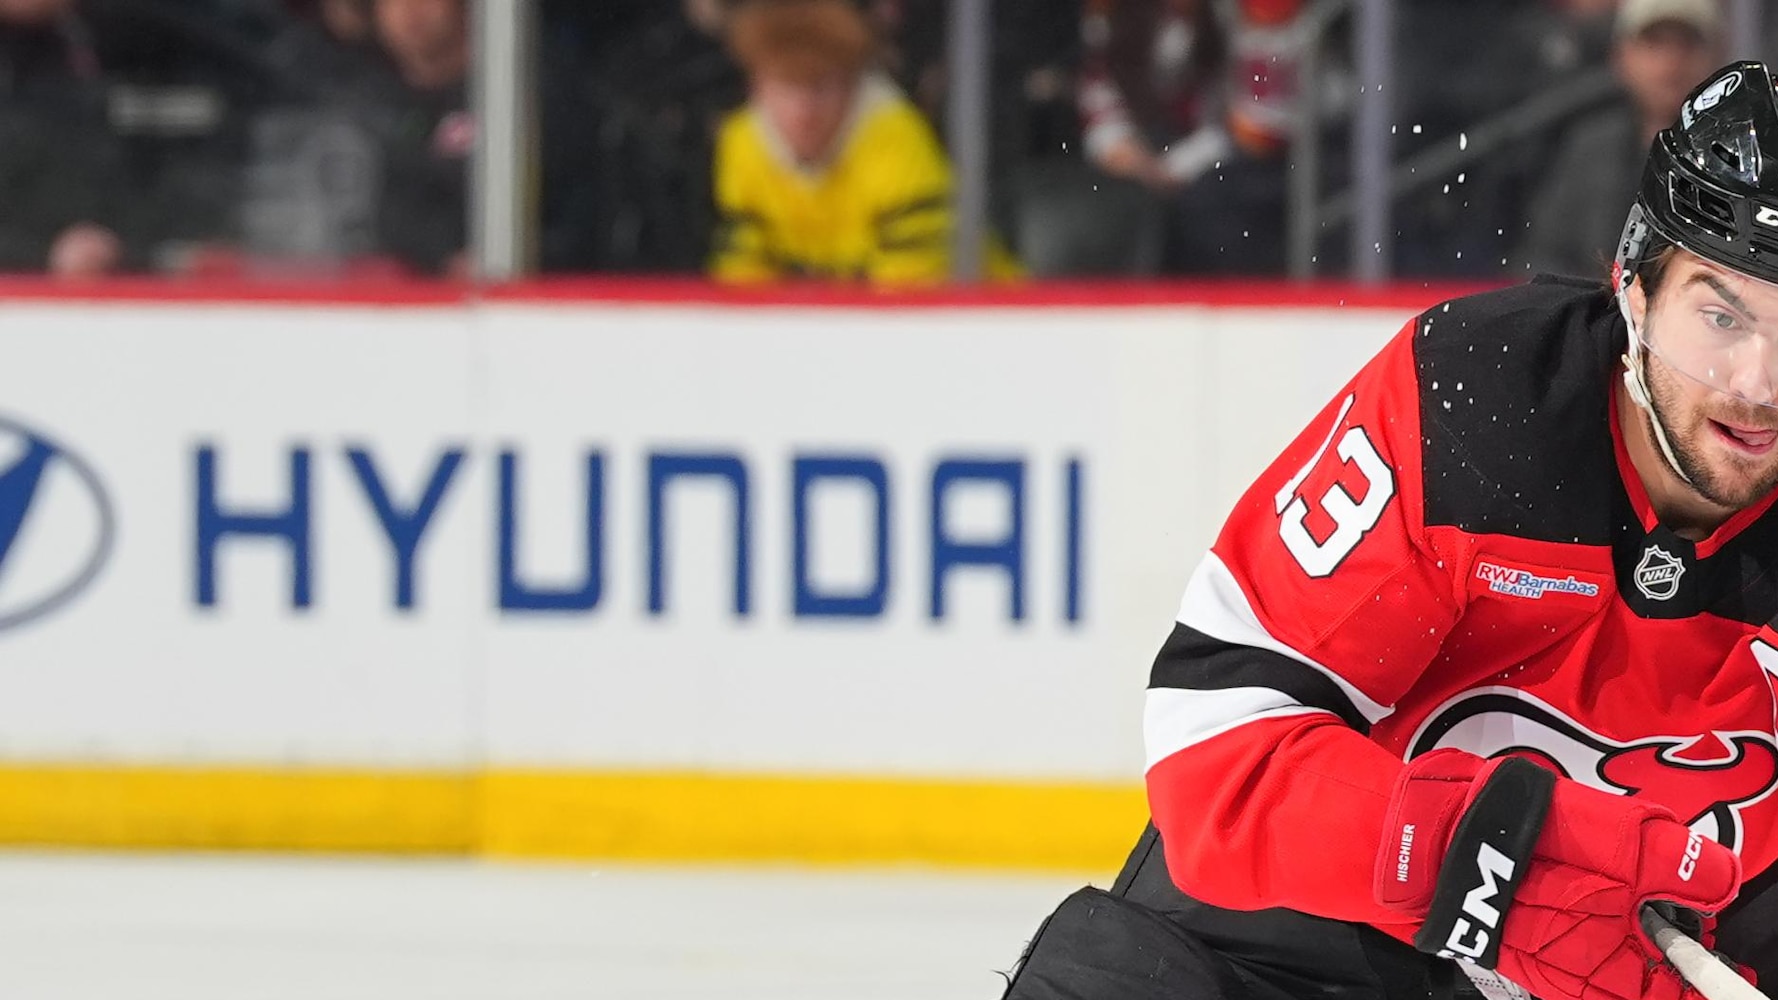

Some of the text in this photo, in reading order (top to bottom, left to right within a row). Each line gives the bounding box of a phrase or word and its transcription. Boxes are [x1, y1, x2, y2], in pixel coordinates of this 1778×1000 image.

[193, 447, 1081, 622] HYUNDAI
[1478, 562, 1598, 595] RWJBarnabas
[1491, 582, 1541, 597] HEALTH
[1642, 568, 1674, 582] NHL
[1397, 824, 1415, 882] HISCHIER
[1678, 830, 1703, 882] CC
[1436, 841, 1516, 964] CM
